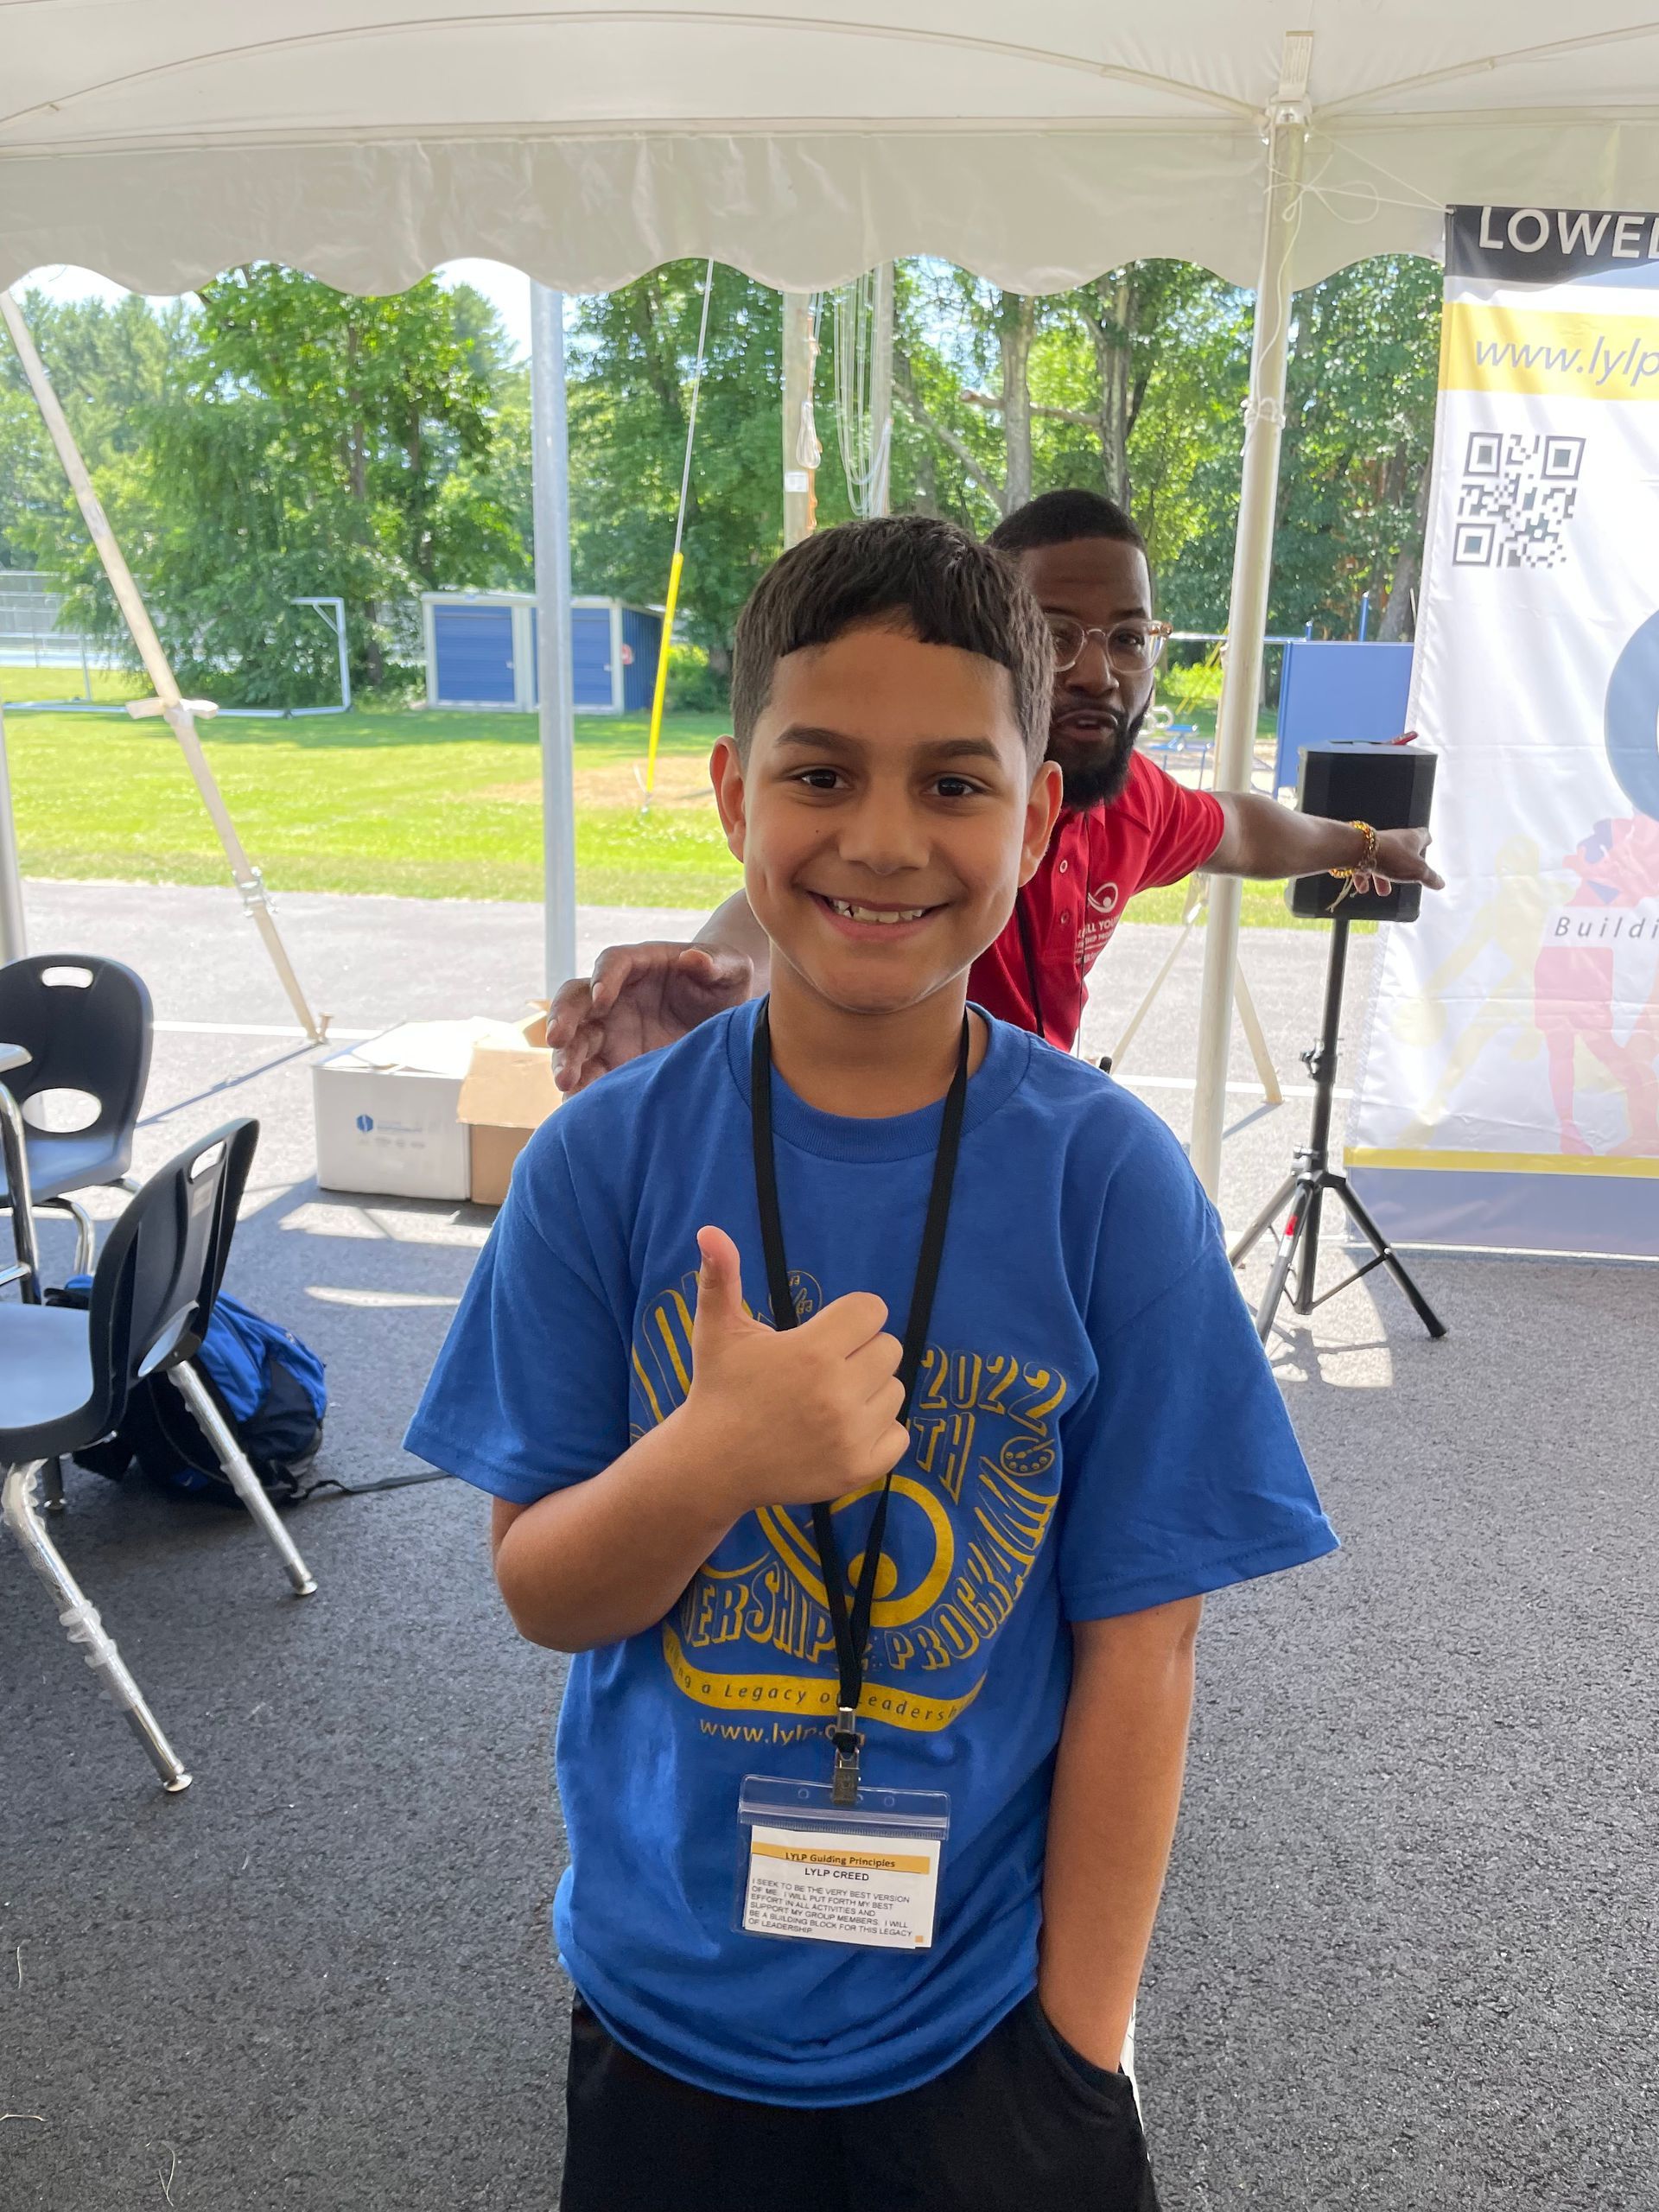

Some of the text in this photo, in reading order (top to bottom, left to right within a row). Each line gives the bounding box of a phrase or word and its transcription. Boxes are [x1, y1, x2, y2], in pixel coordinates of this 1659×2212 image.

[919, 1343, 1067, 1438] 2022
[702, 1684, 711, 1694] a
[724, 1684, 806, 1705] Legacy
[785, 1852, 896, 1868] LYLP Guiding Principles
[804, 1867, 869, 1881] LYLP CREED
[757, 1878, 779, 1887] SEEK
[781, 1882, 792, 1891] TO
[807, 1885, 823, 1894] THE
[825, 1888, 848, 1897] VERY
[849, 1891, 871, 1899] BEST
[873, 1893, 910, 1904] VERSION
[751, 1893, 783, 1904] EFFORT
[811, 1904, 855, 1915] ACTIVITIES
[788, 1892, 807, 1901] WILL
[828, 1897, 856, 1906] FORTH
[872, 1902, 893, 1910] BEST
[750, 1902, 788, 1914] SUPPORT
[805, 1910, 836, 1920] GROUP
[761, 1921, 813, 1933] LEADERSHIP
[770, 1913, 808, 1925] BUILDING
[810, 1919, 836, 1929] BLOCK
[859, 1925, 877, 1934] THIS
[880, 1929, 912, 1937] LEGACY
